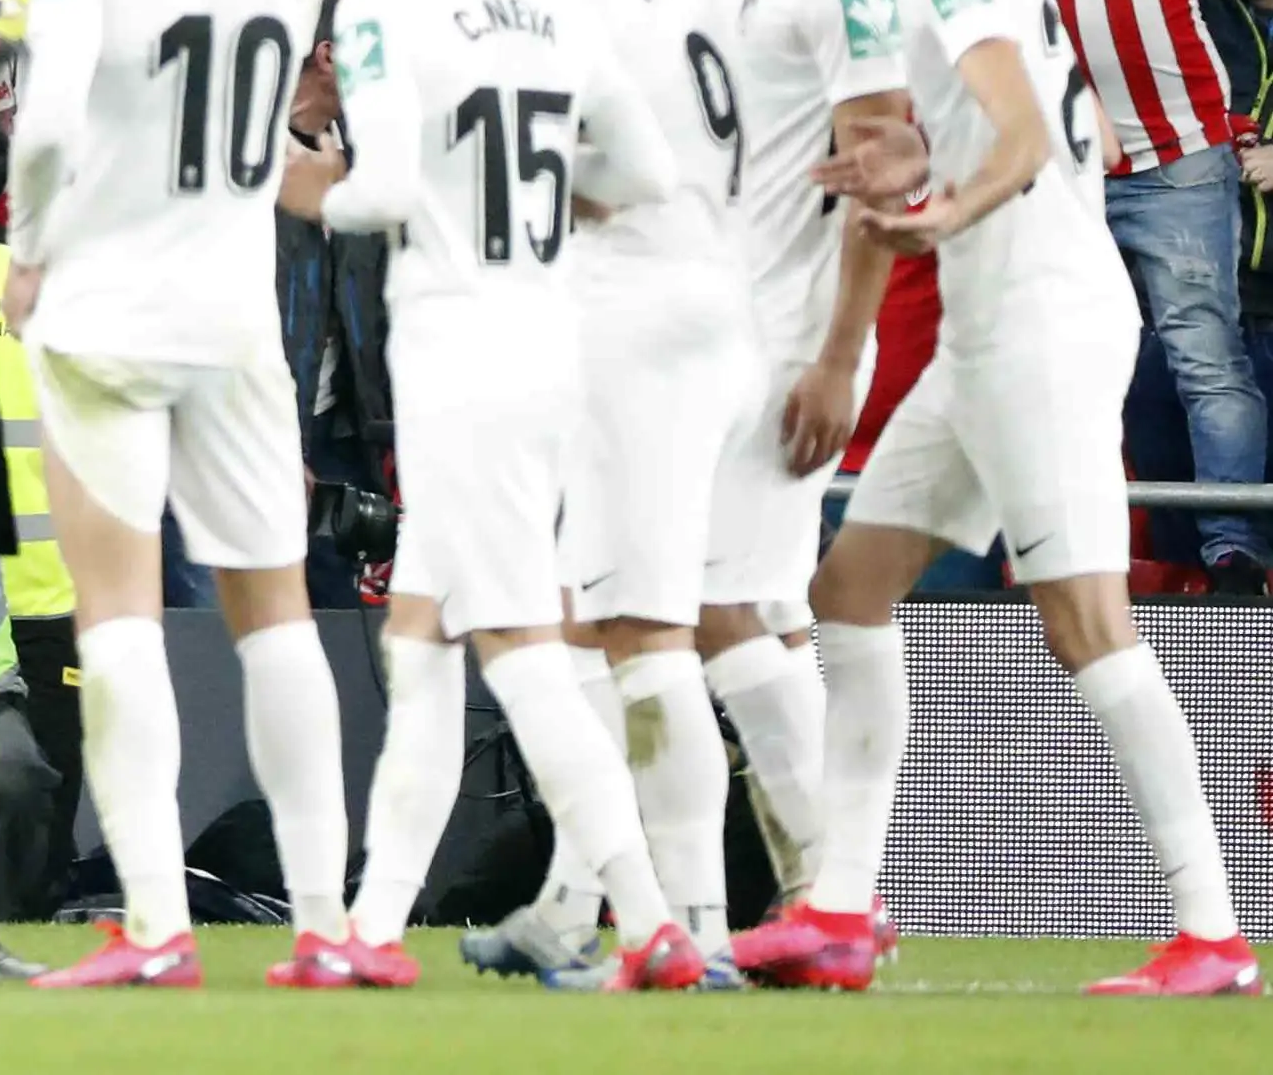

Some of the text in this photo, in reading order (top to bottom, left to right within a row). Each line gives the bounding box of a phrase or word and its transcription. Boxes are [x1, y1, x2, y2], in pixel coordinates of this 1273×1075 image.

[150, 13, 293, 196] 10
[448, 86, 574, 264] 15
[684, 31, 744, 202] 9
